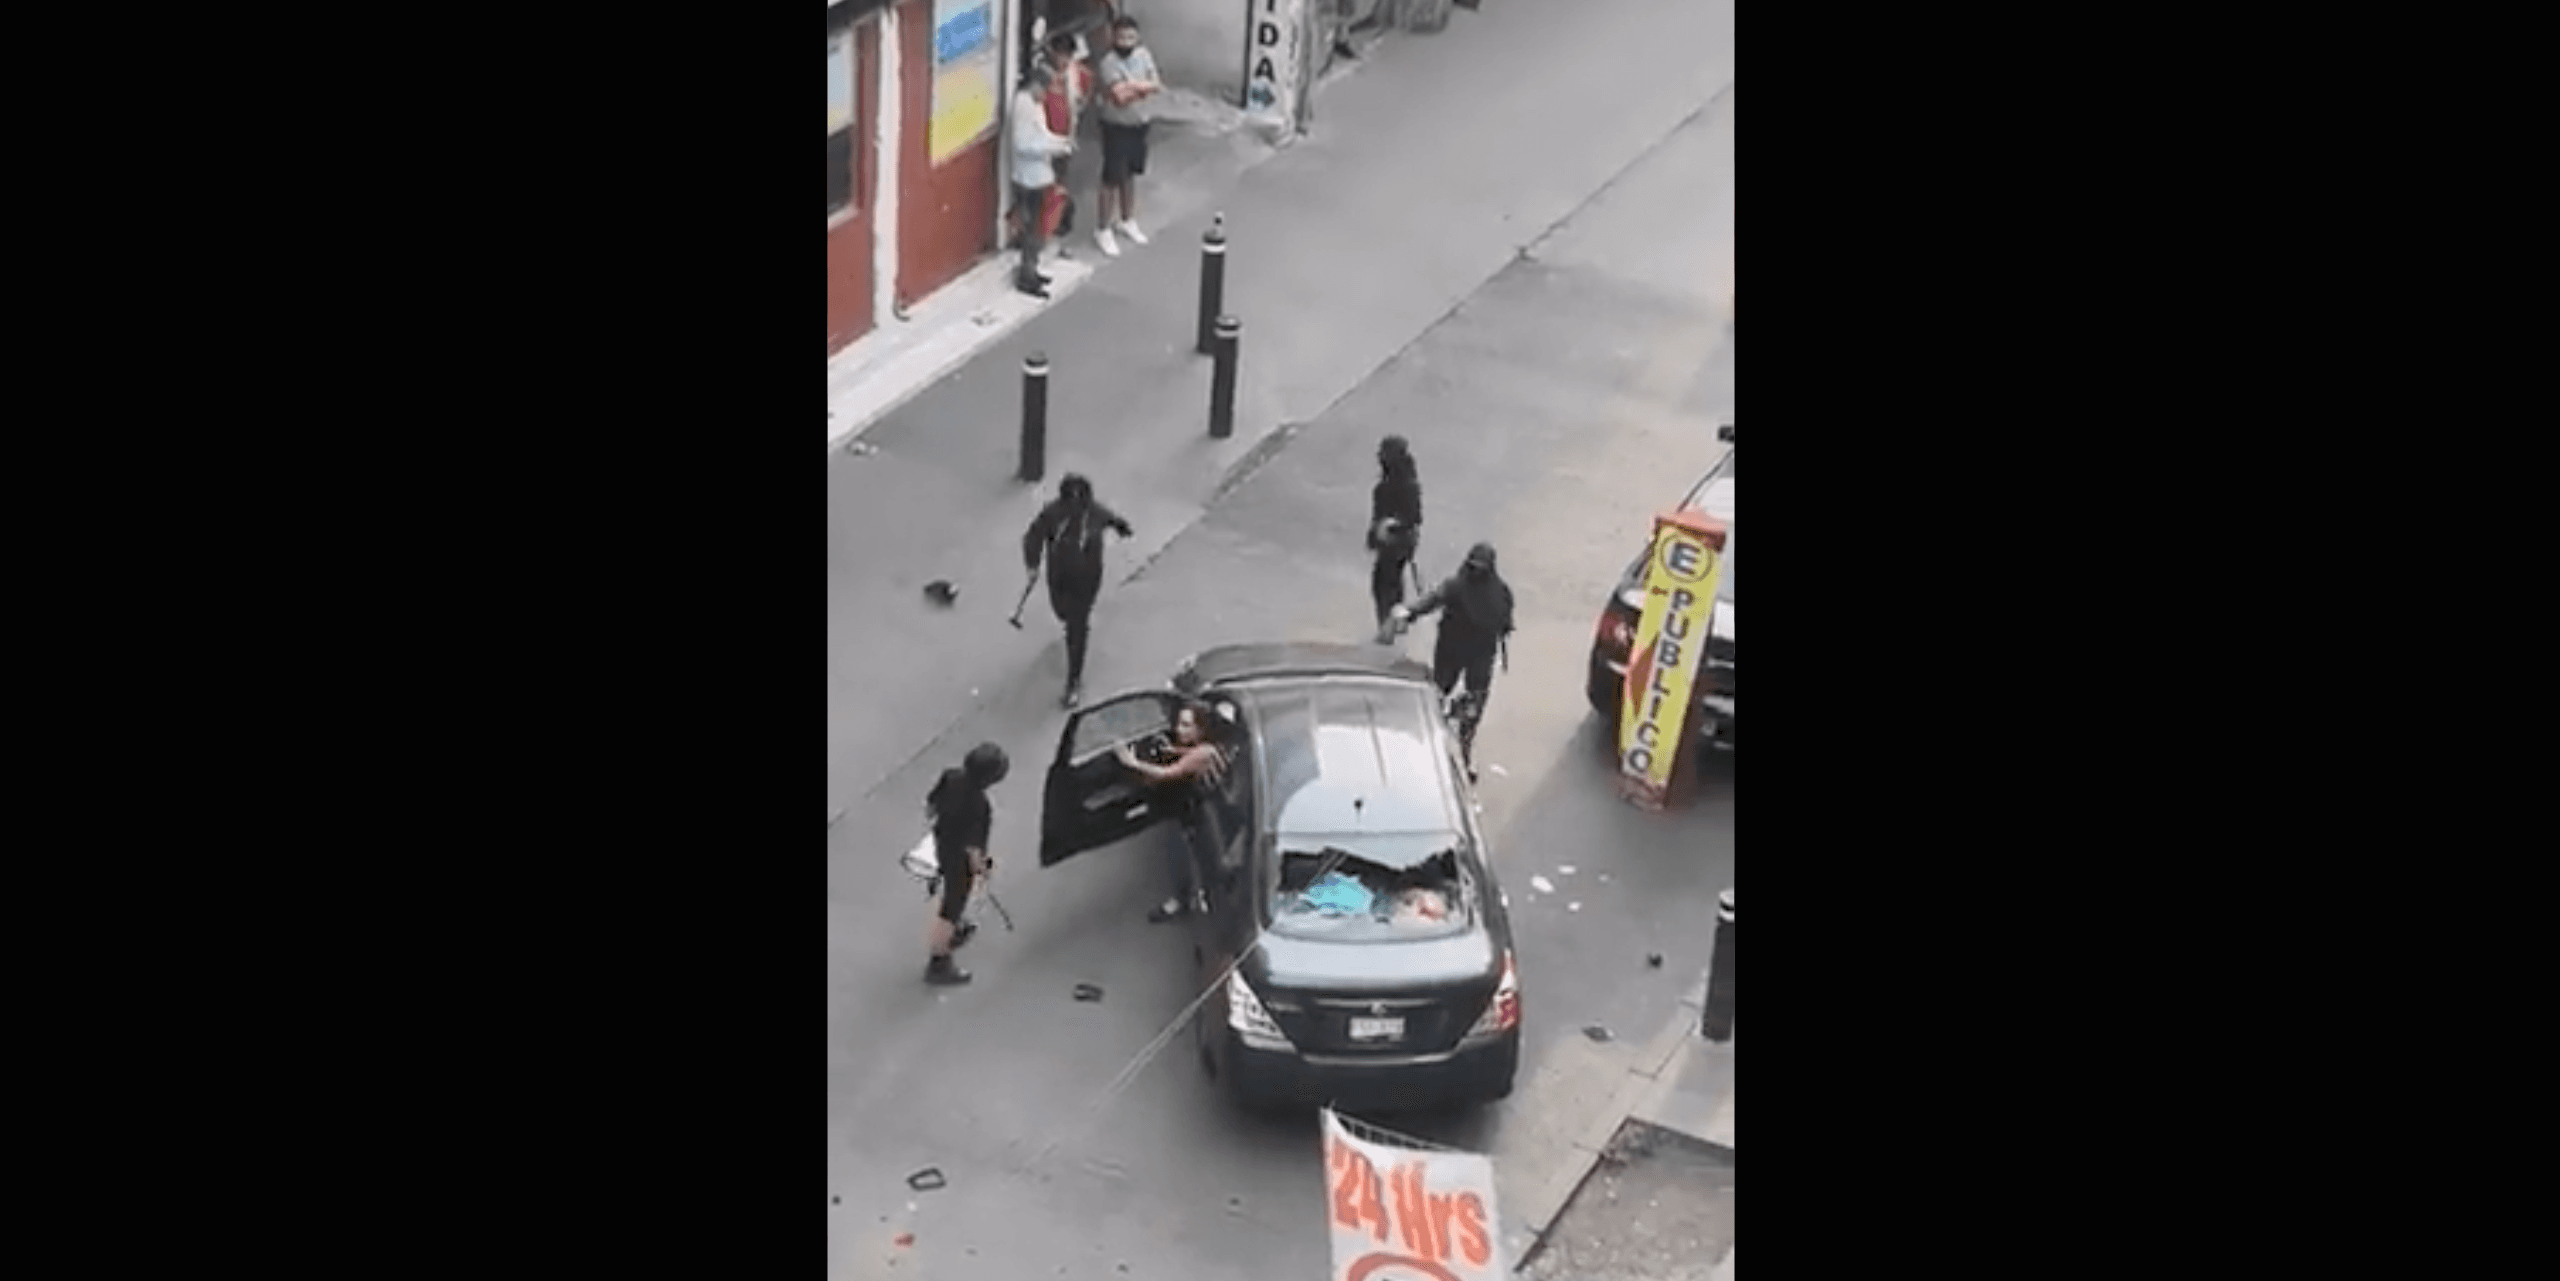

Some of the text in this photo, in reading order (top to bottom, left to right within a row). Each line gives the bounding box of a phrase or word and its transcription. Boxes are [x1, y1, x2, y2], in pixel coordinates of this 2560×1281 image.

[1669, 541, 1701, 576] E
[1628, 587, 1695, 773] PUBLICO
[1331, 1134, 1491, 1267] 24 Hrs
